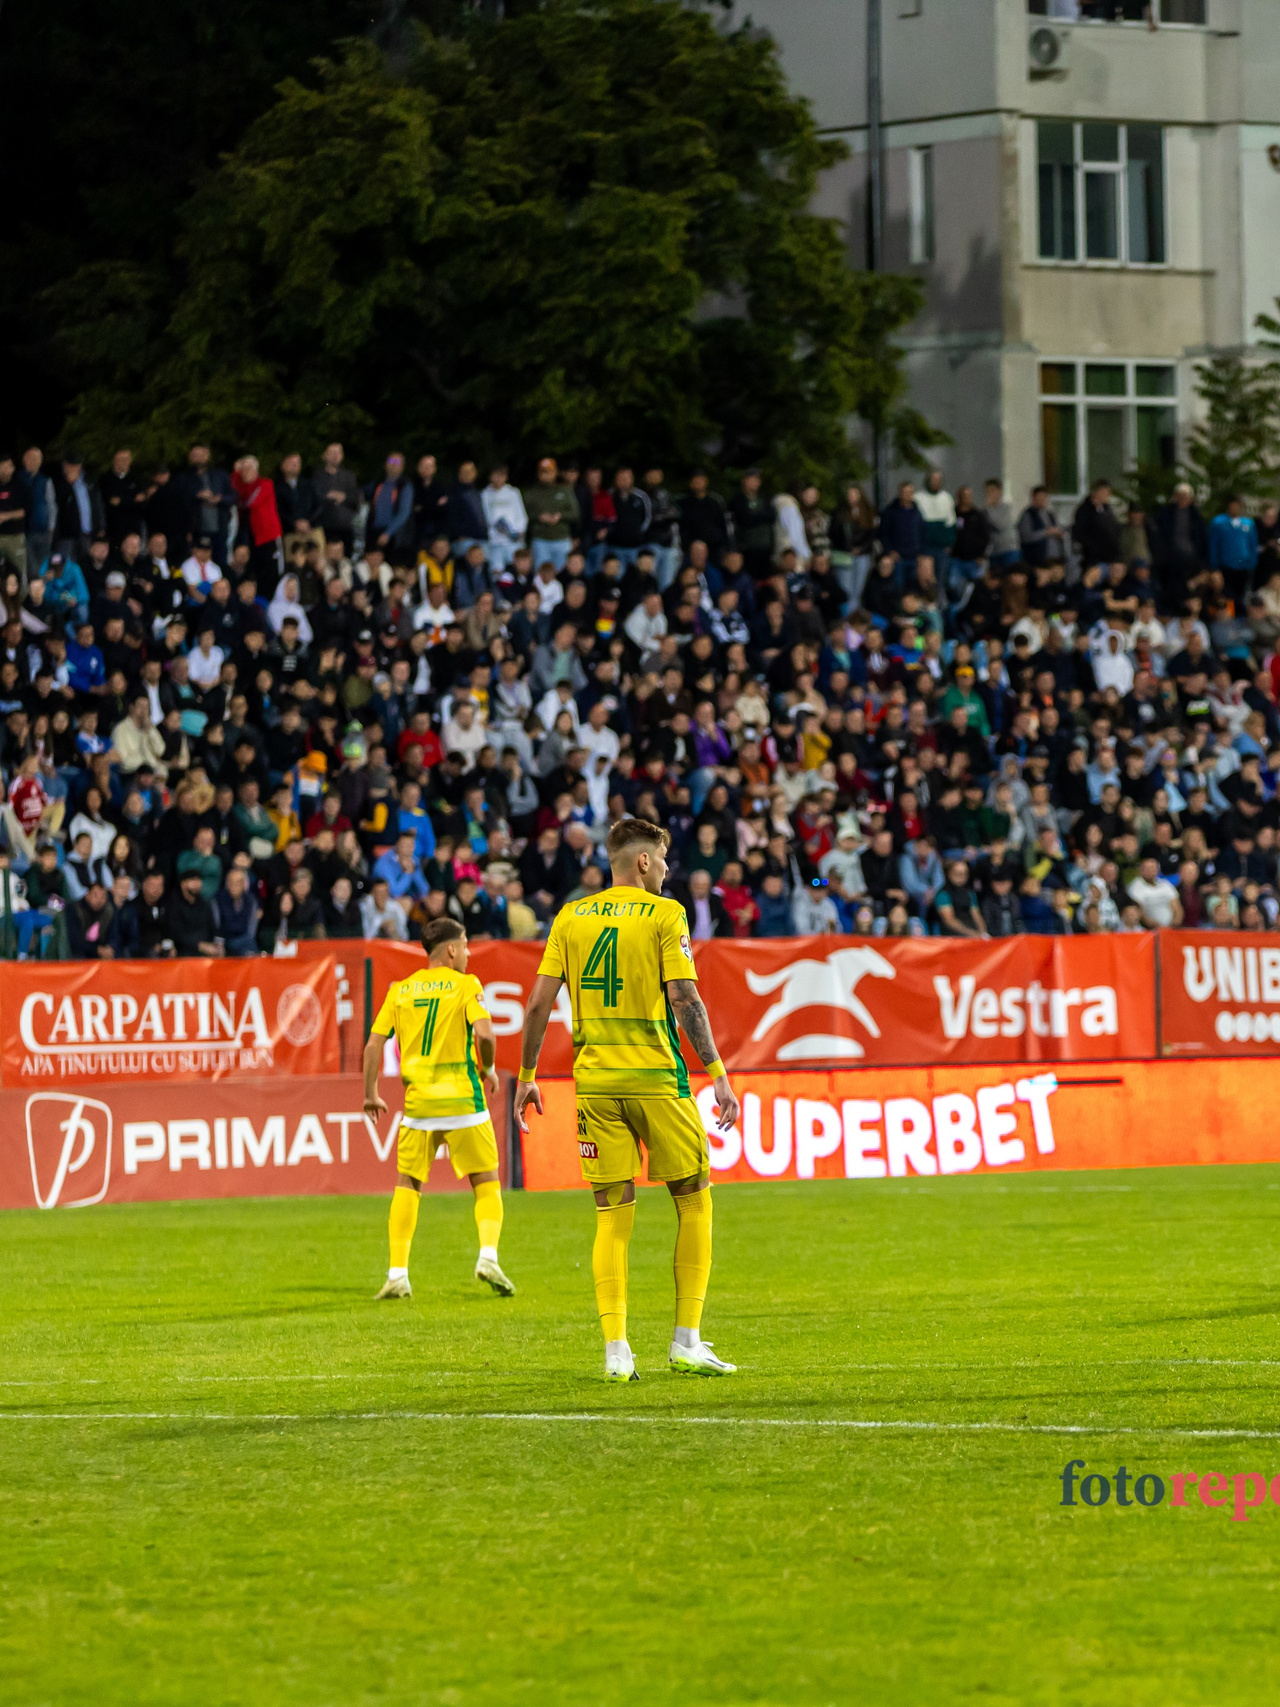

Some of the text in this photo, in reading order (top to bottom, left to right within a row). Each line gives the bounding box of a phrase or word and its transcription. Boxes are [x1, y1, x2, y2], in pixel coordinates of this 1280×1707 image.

[574, 902, 656, 917] GARUTTI
[581, 927, 623, 1007] 4
[20, 987, 273, 1054] CARPATINA
[414, 998, 440, 1057] 7
[932, 975, 1118, 1039] Vestra
[21, 1055, 54, 1076] APA
[151, 1051, 176, 1074] CU
[696, 1072, 1058, 1179] SUPERBET
